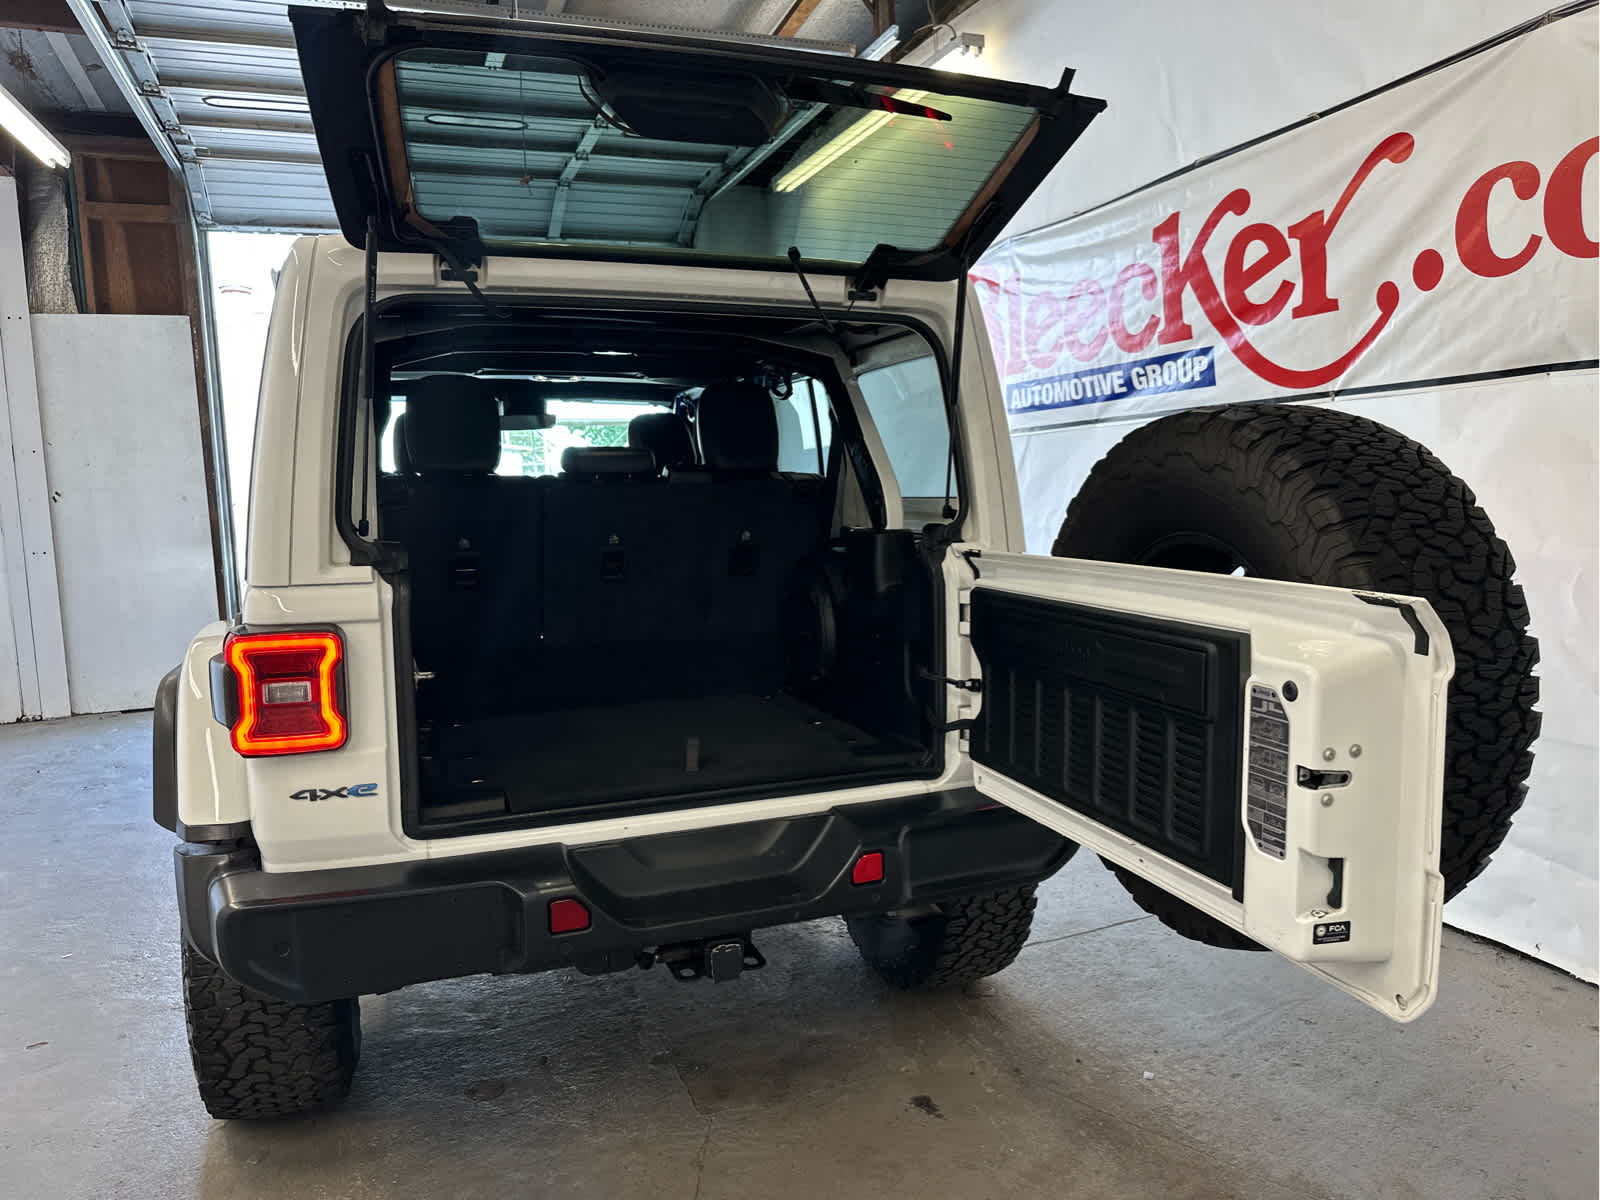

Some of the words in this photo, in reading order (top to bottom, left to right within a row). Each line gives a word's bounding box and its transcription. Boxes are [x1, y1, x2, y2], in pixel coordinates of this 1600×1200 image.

[1011, 370, 1127, 409] AUTOMOTIVE
[1131, 354, 1209, 391] GROUP
[1328, 924, 1346, 932] FCA
